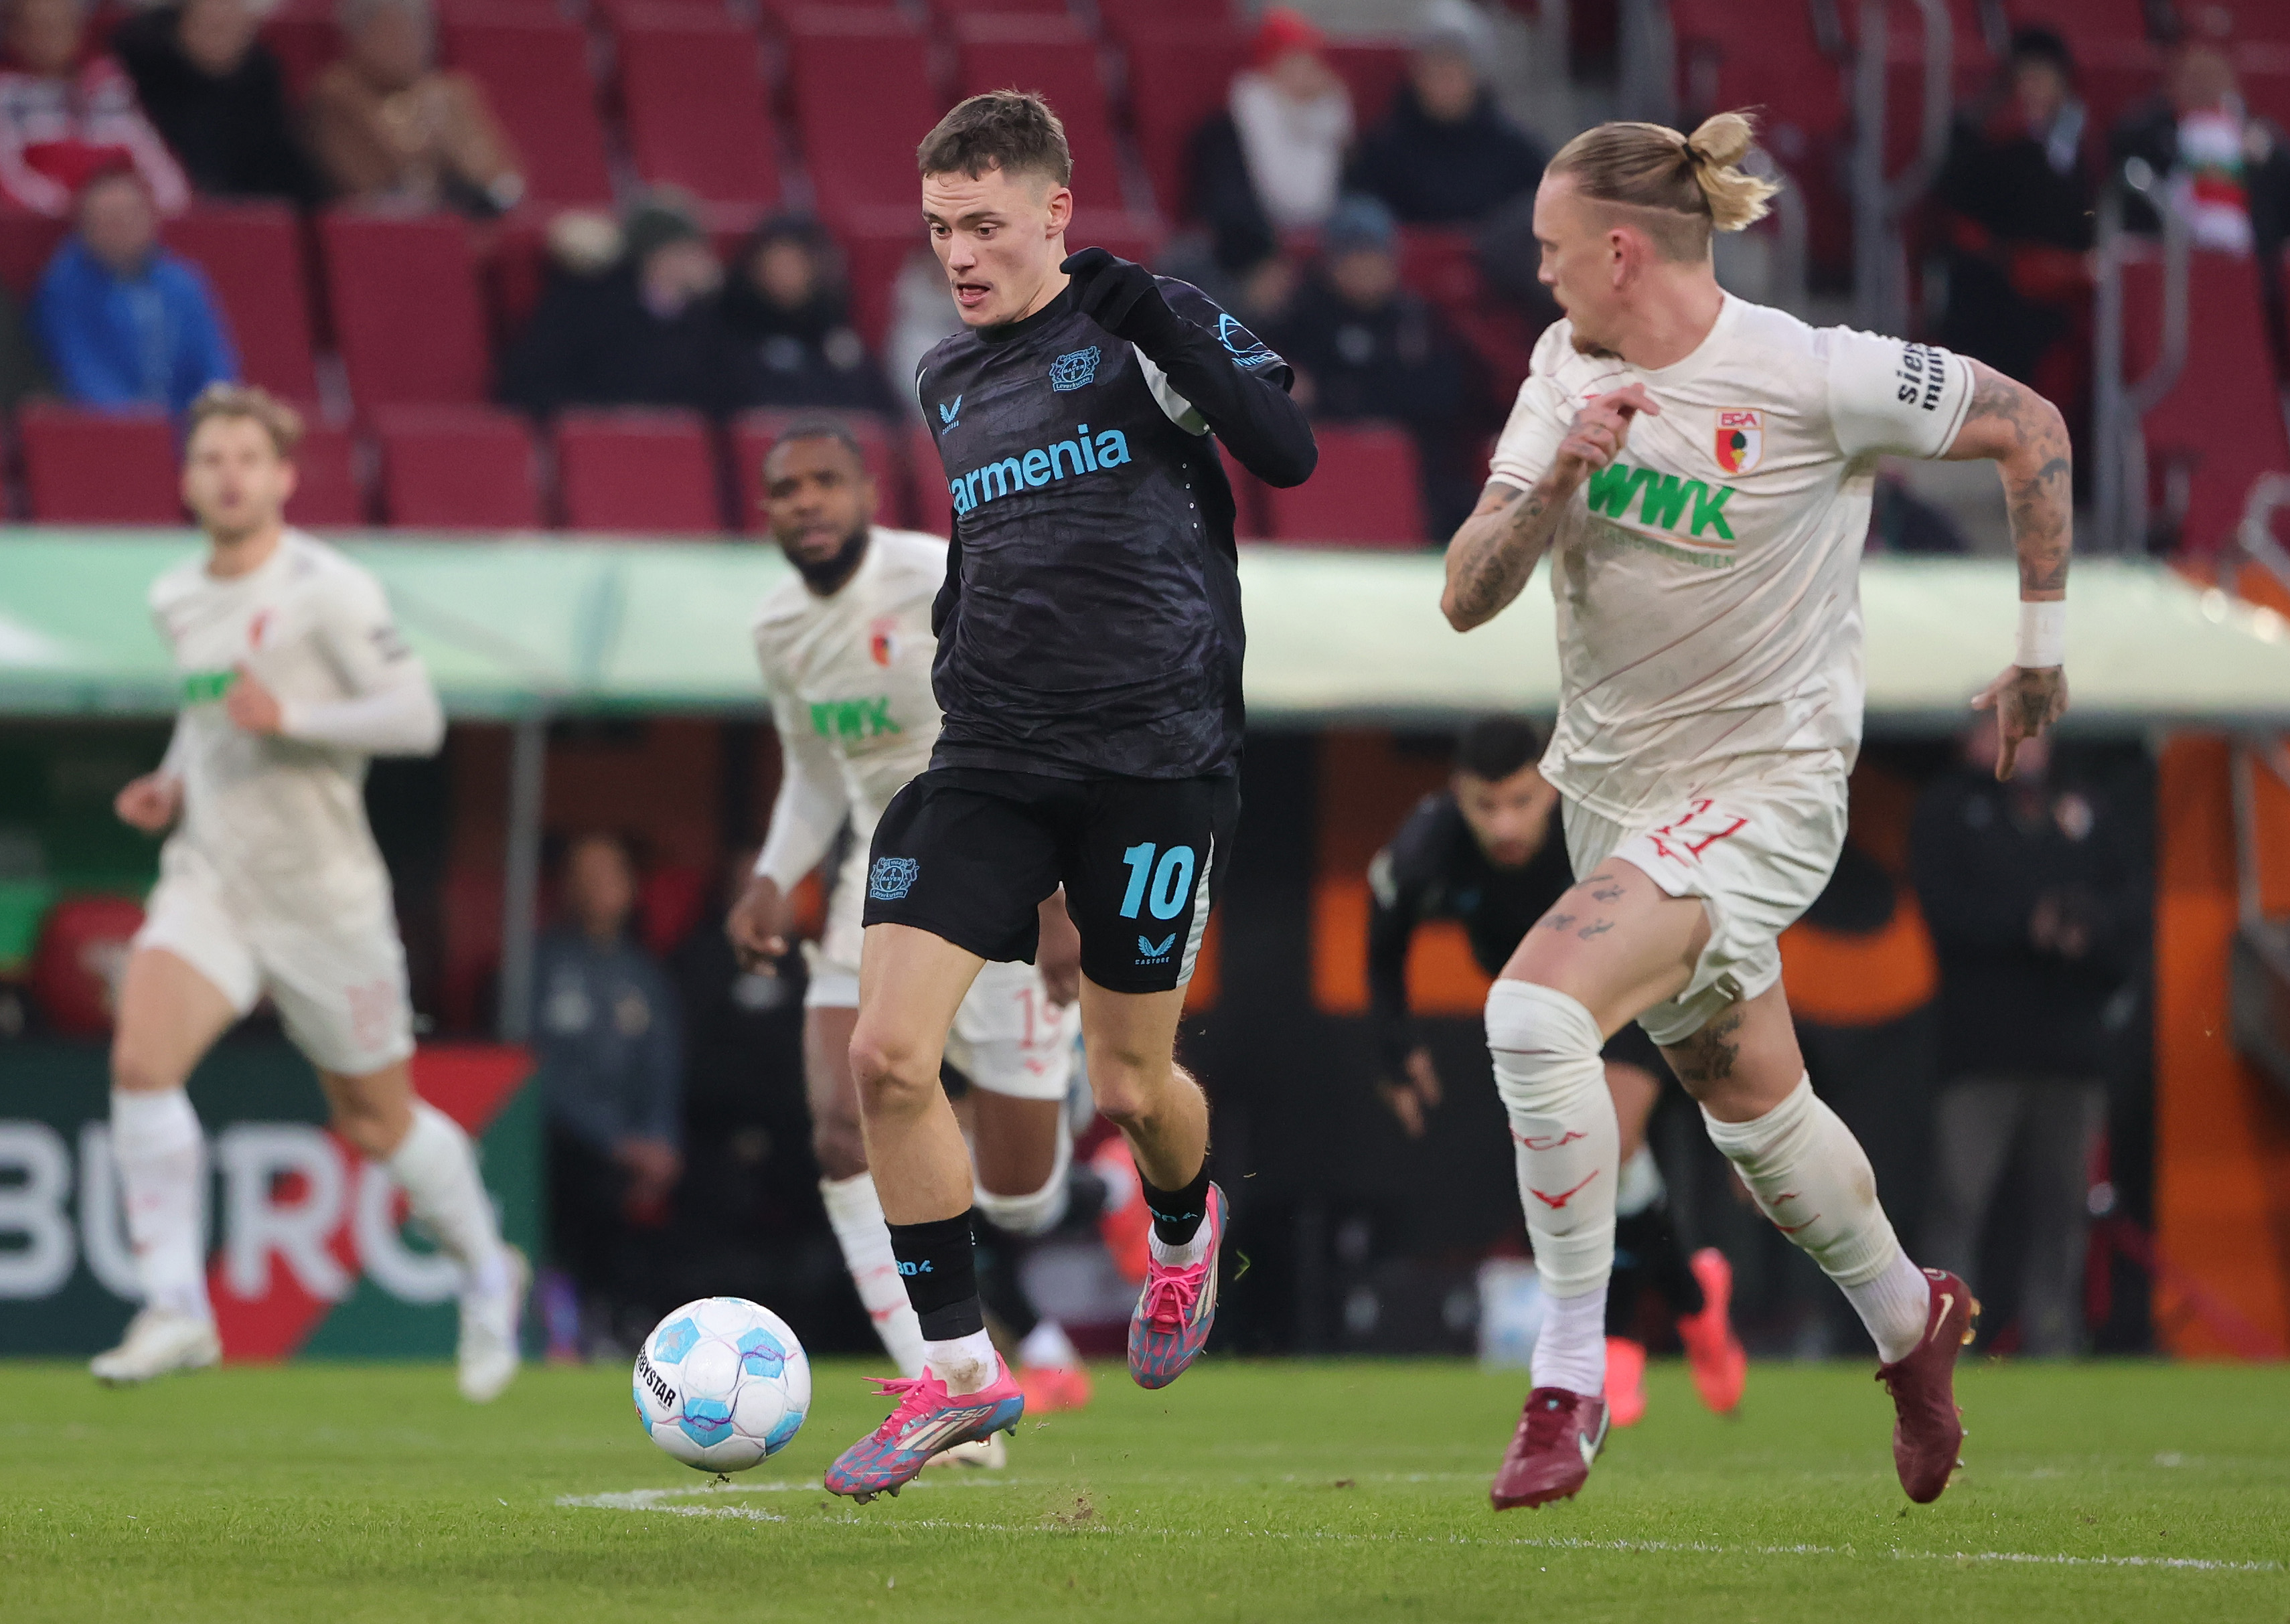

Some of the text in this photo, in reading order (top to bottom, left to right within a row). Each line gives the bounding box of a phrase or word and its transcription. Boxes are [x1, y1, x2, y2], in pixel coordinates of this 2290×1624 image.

[949, 424, 1132, 515] armenia
[1588, 463, 1736, 540] WWK
[1119, 841, 1195, 920] 10
